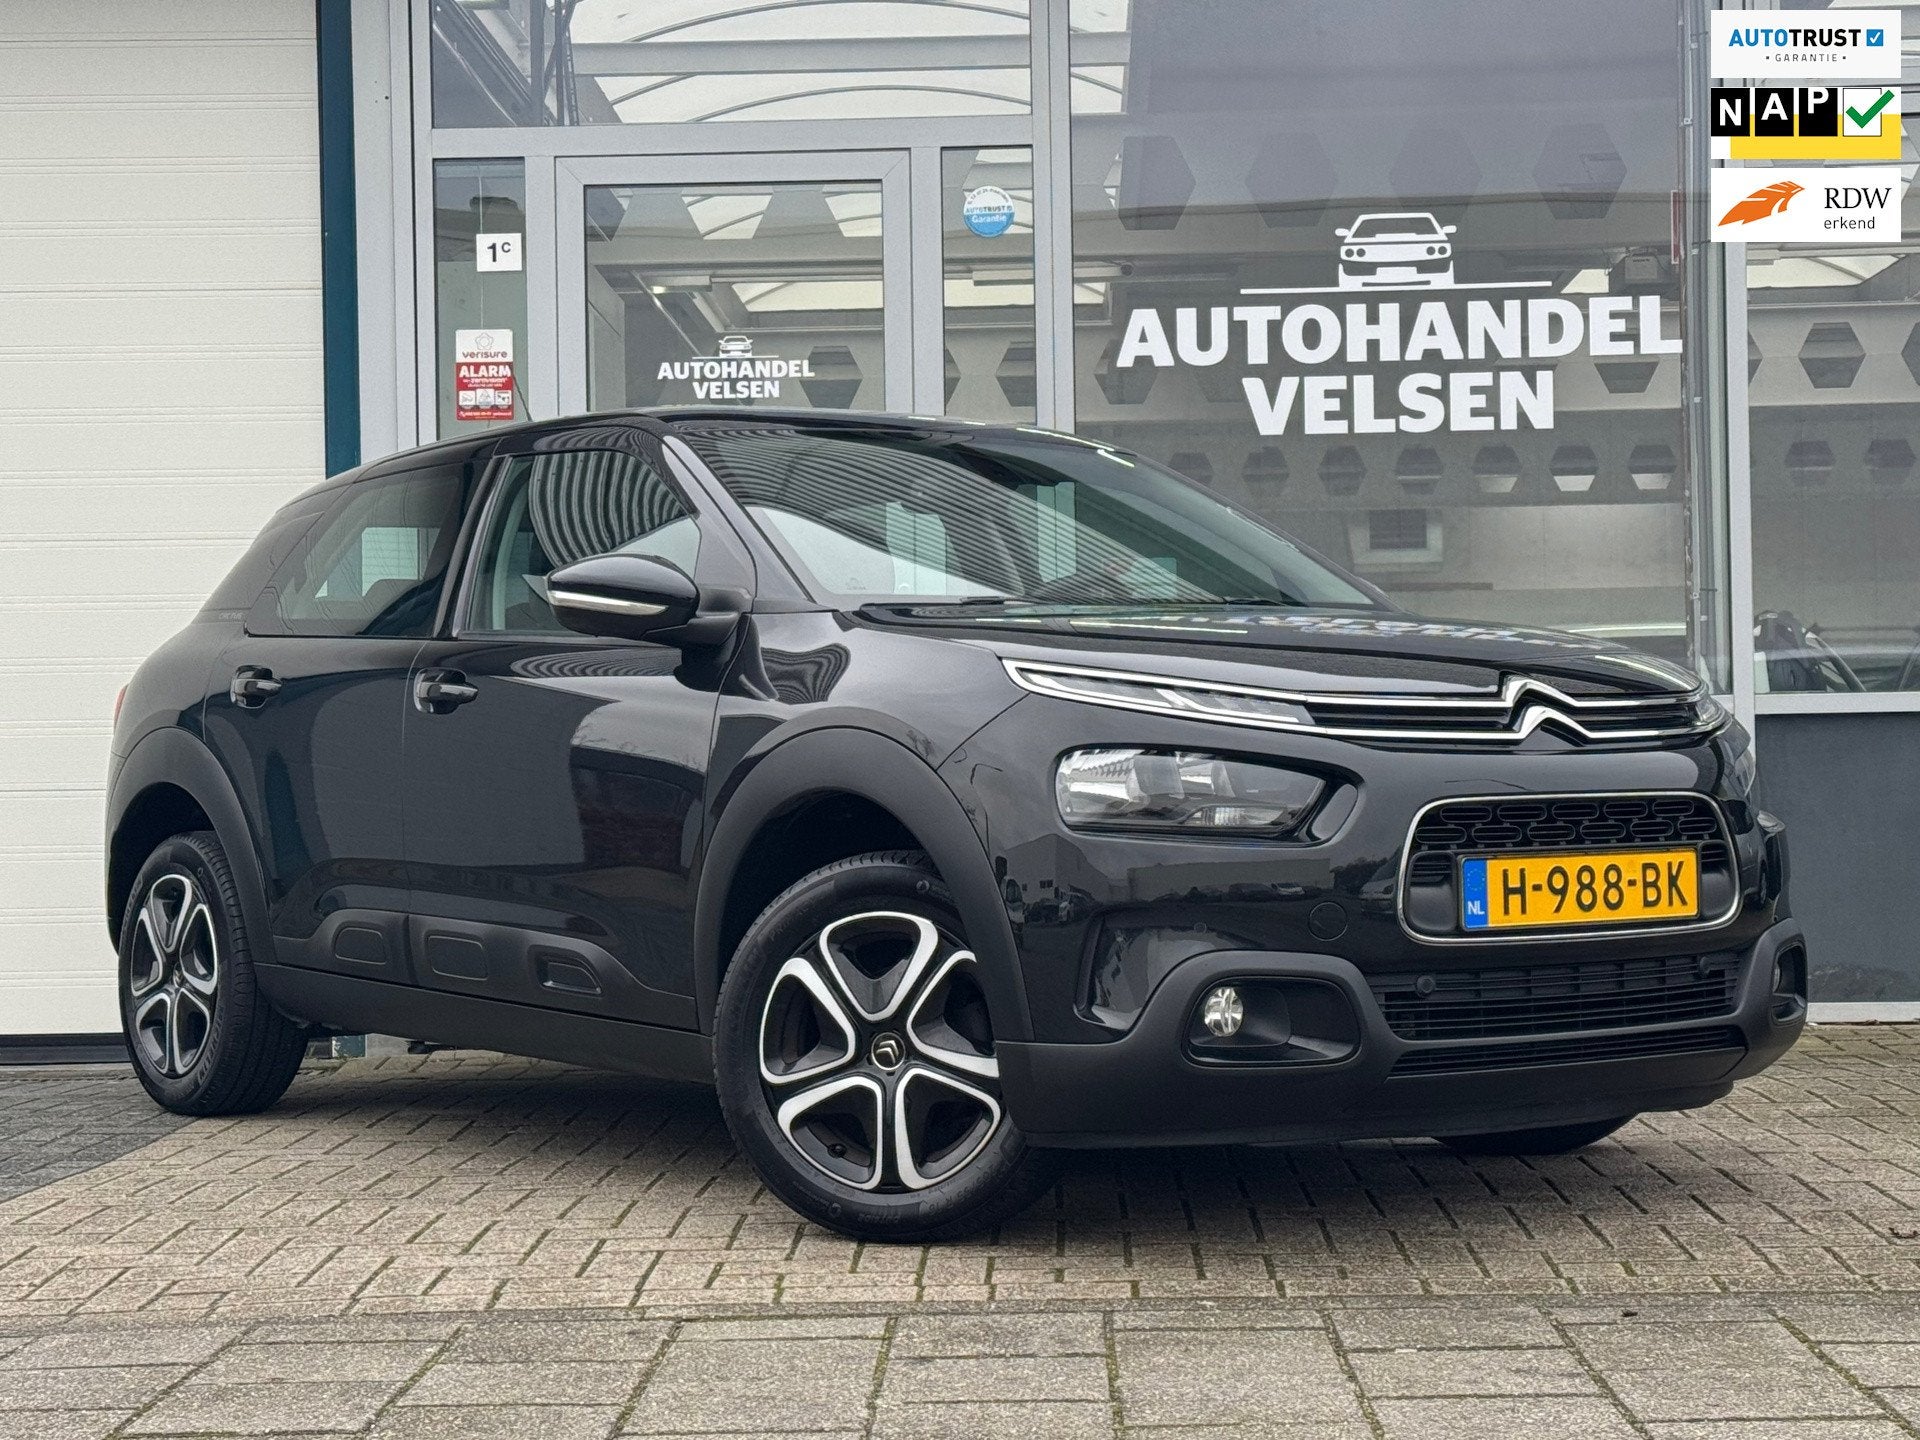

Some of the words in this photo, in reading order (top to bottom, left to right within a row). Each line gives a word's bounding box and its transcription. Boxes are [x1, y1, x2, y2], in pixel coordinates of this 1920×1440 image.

[971, 214, 1007, 224] Garantie
[1116, 294, 1684, 368] AUTOHANDEL
[462, 350, 508, 359] verisure
[459, 365, 512, 377] ALARM
[657, 359, 816, 380] AUTOHANDEL
[692, 380, 780, 399] VELSEN
[1241, 369, 1555, 436] VELSEN
[1502, 860, 1689, 916] H-988-BK
[1467, 901, 1485, 915] NL
